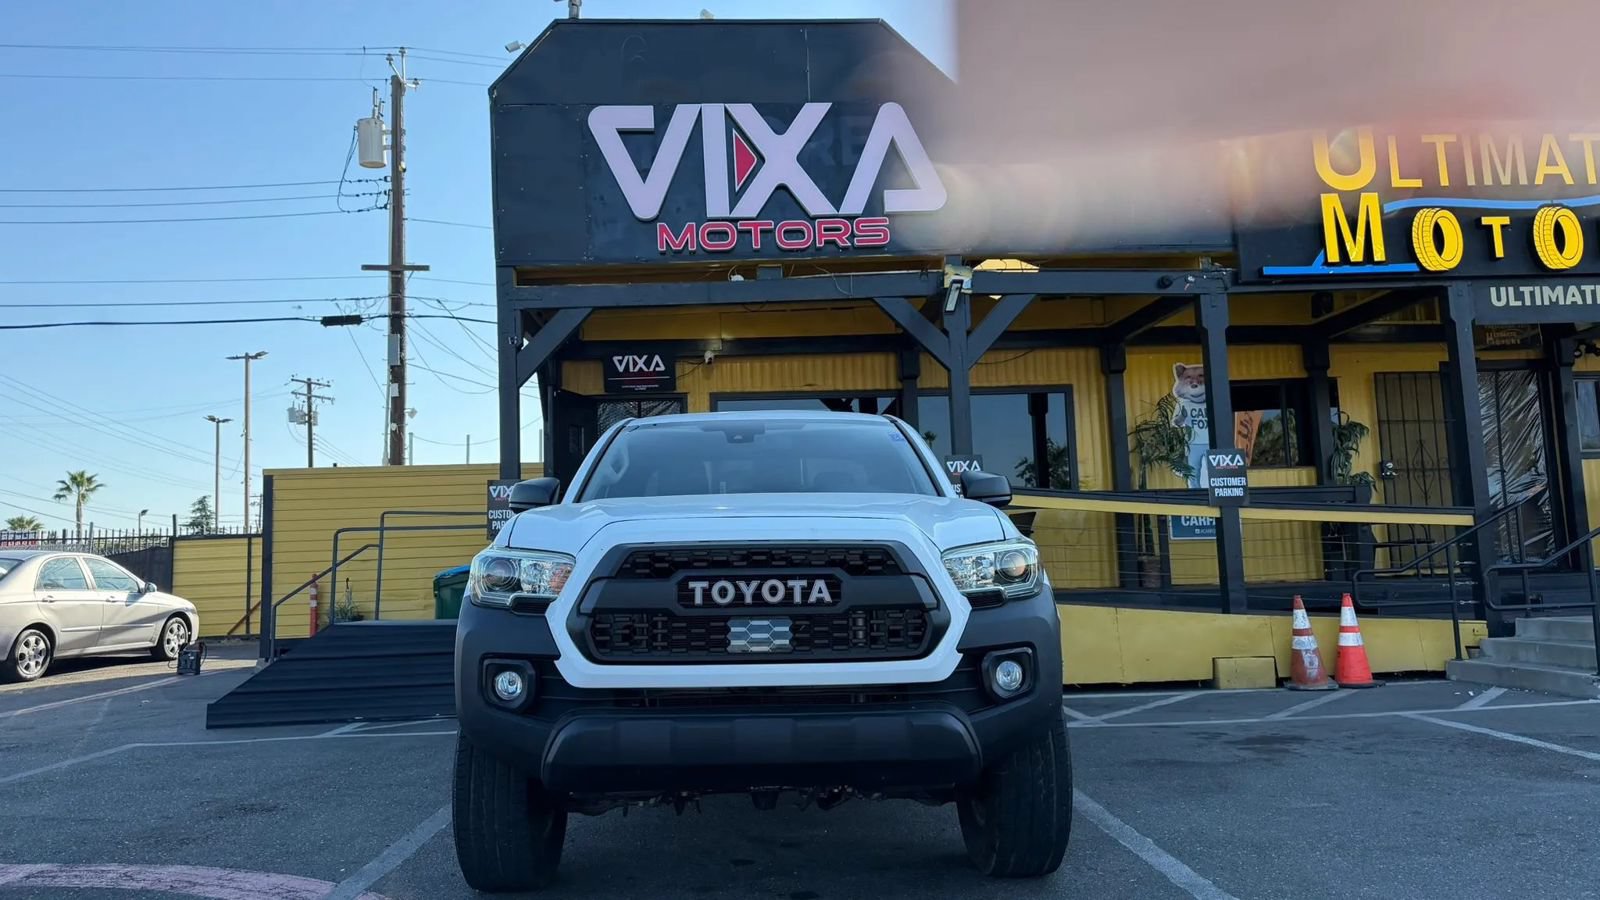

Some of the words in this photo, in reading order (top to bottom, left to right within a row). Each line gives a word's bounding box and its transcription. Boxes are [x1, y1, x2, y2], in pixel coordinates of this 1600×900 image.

[588, 102, 947, 219] VIXA
[656, 217, 891, 251] MOTORS
[612, 354, 666, 373] VIXA
[946, 460, 981, 473] VIXA
[1208, 454, 1244, 467] VIXA
[1210, 477, 1246, 487] CUSTOMER
[1214, 487, 1244, 497] PARKING
[488, 509, 514, 519] CUSTO
[688, 579, 832, 606] TOYOTA
